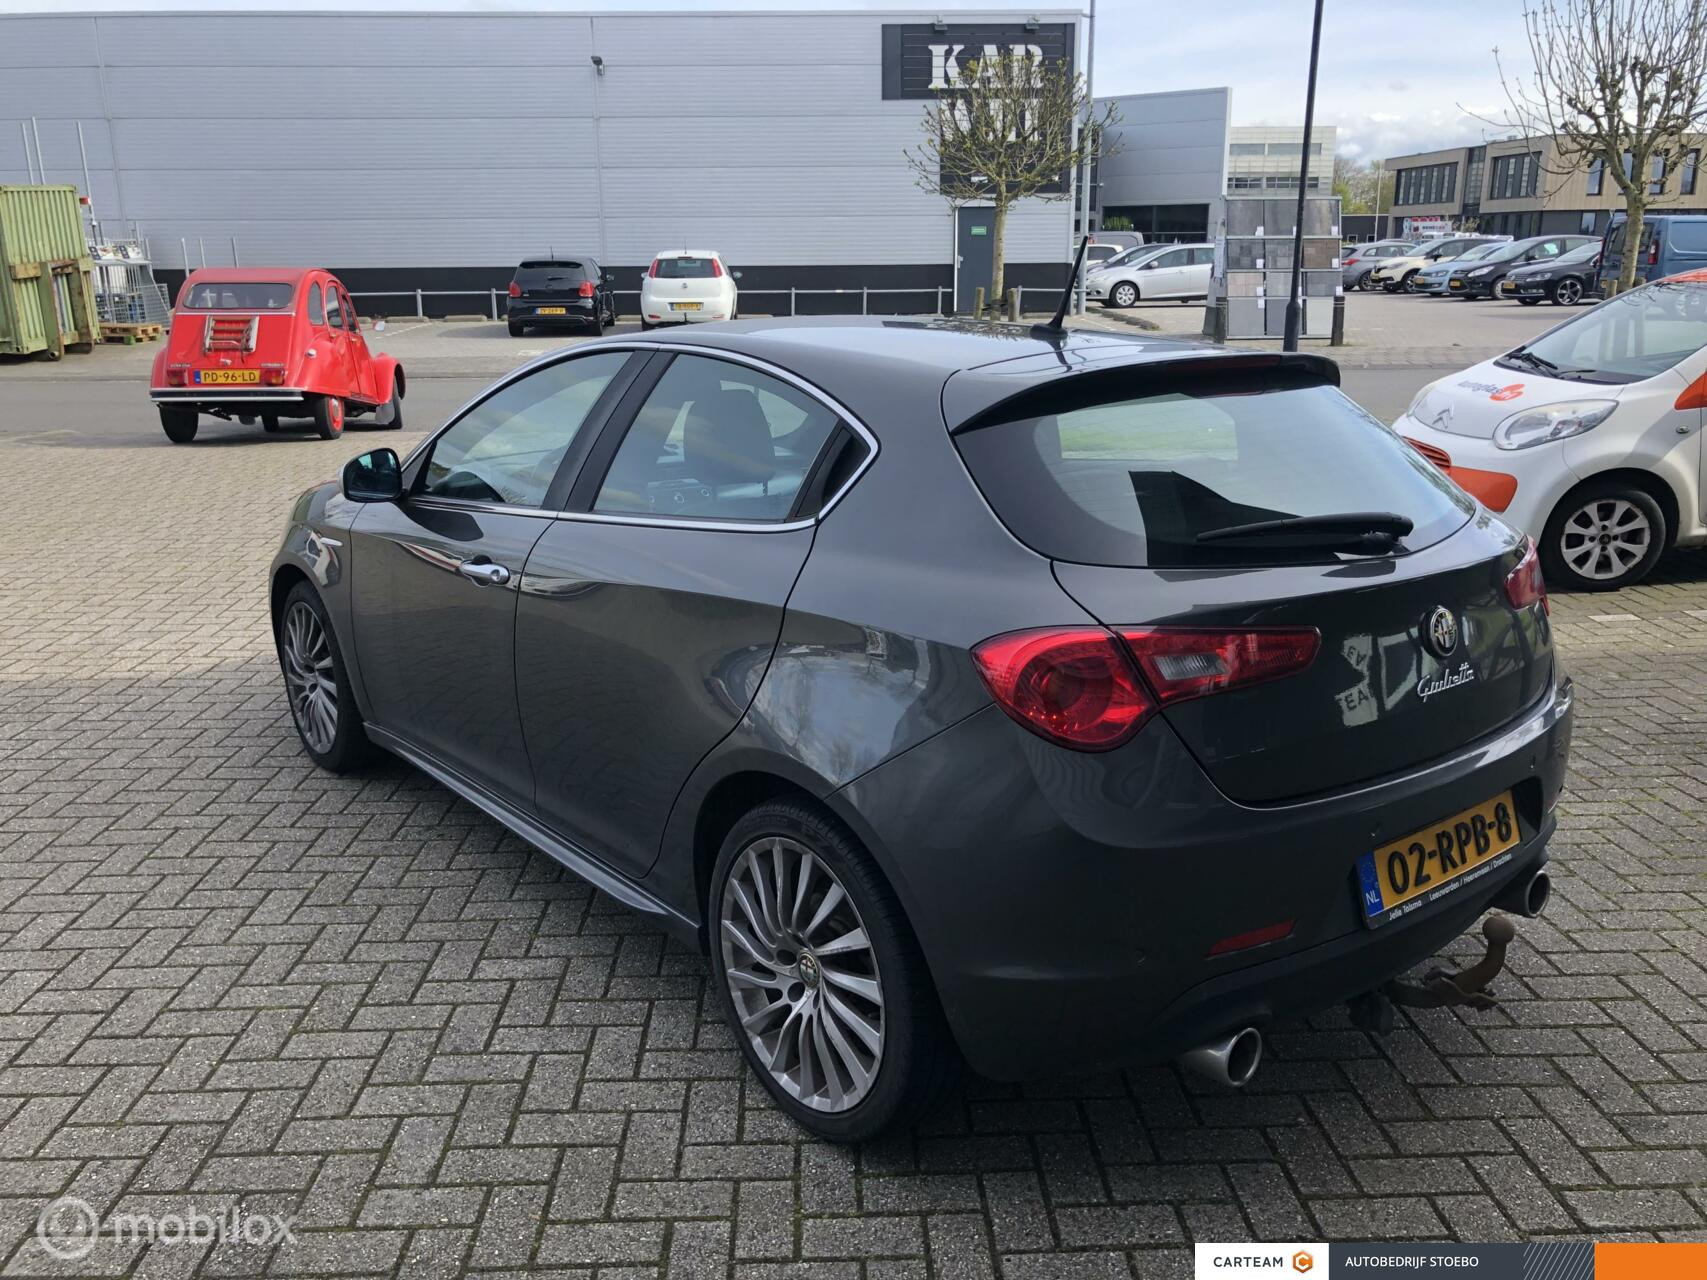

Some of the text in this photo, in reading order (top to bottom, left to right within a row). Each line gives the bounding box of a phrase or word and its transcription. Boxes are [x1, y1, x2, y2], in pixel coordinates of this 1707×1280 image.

[203, 372, 256, 382] PD-96-LD
[1417, 662, 1474, 703] Giulietta
[1387, 802, 1512, 894] 02-RPB-8
[1366, 891, 1380, 906] NL
